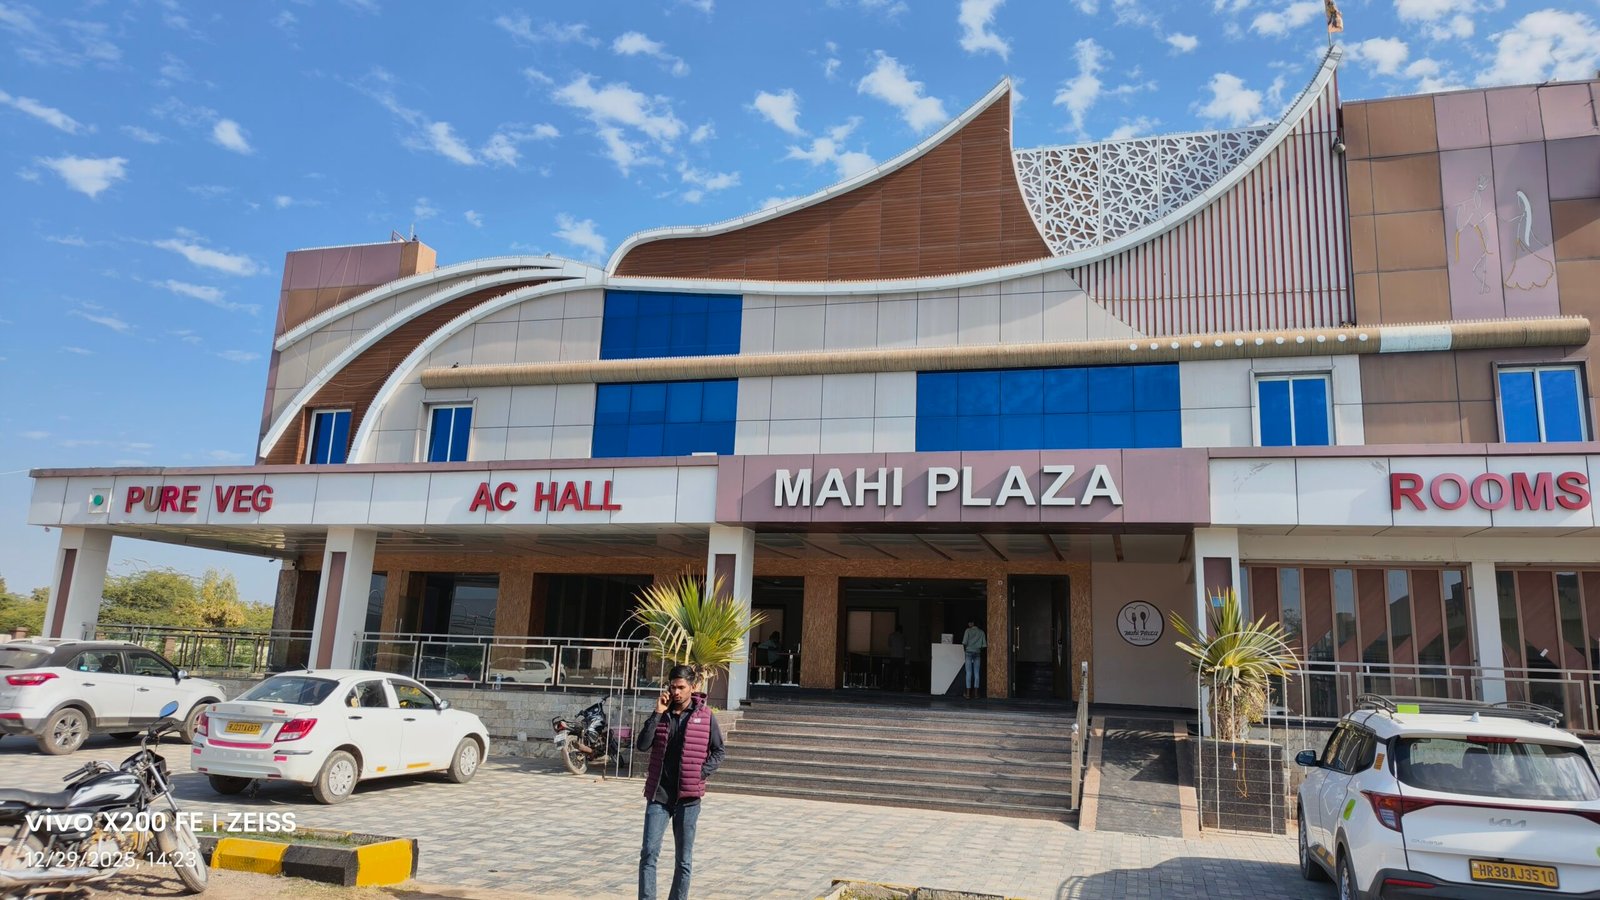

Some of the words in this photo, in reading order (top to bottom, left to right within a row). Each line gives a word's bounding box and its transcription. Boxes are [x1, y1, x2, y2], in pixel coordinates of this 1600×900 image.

[125, 485, 201, 513] PURE
[215, 484, 274, 513] VEG
[469, 481, 518, 512] AC
[534, 480, 623, 512] HALL
[774, 467, 903, 507] MAHI
[927, 464, 1124, 507] PLAZA
[1391, 471, 1592, 511] ROOMS
[1479, 864, 1556, 883] HR38AJ3510
